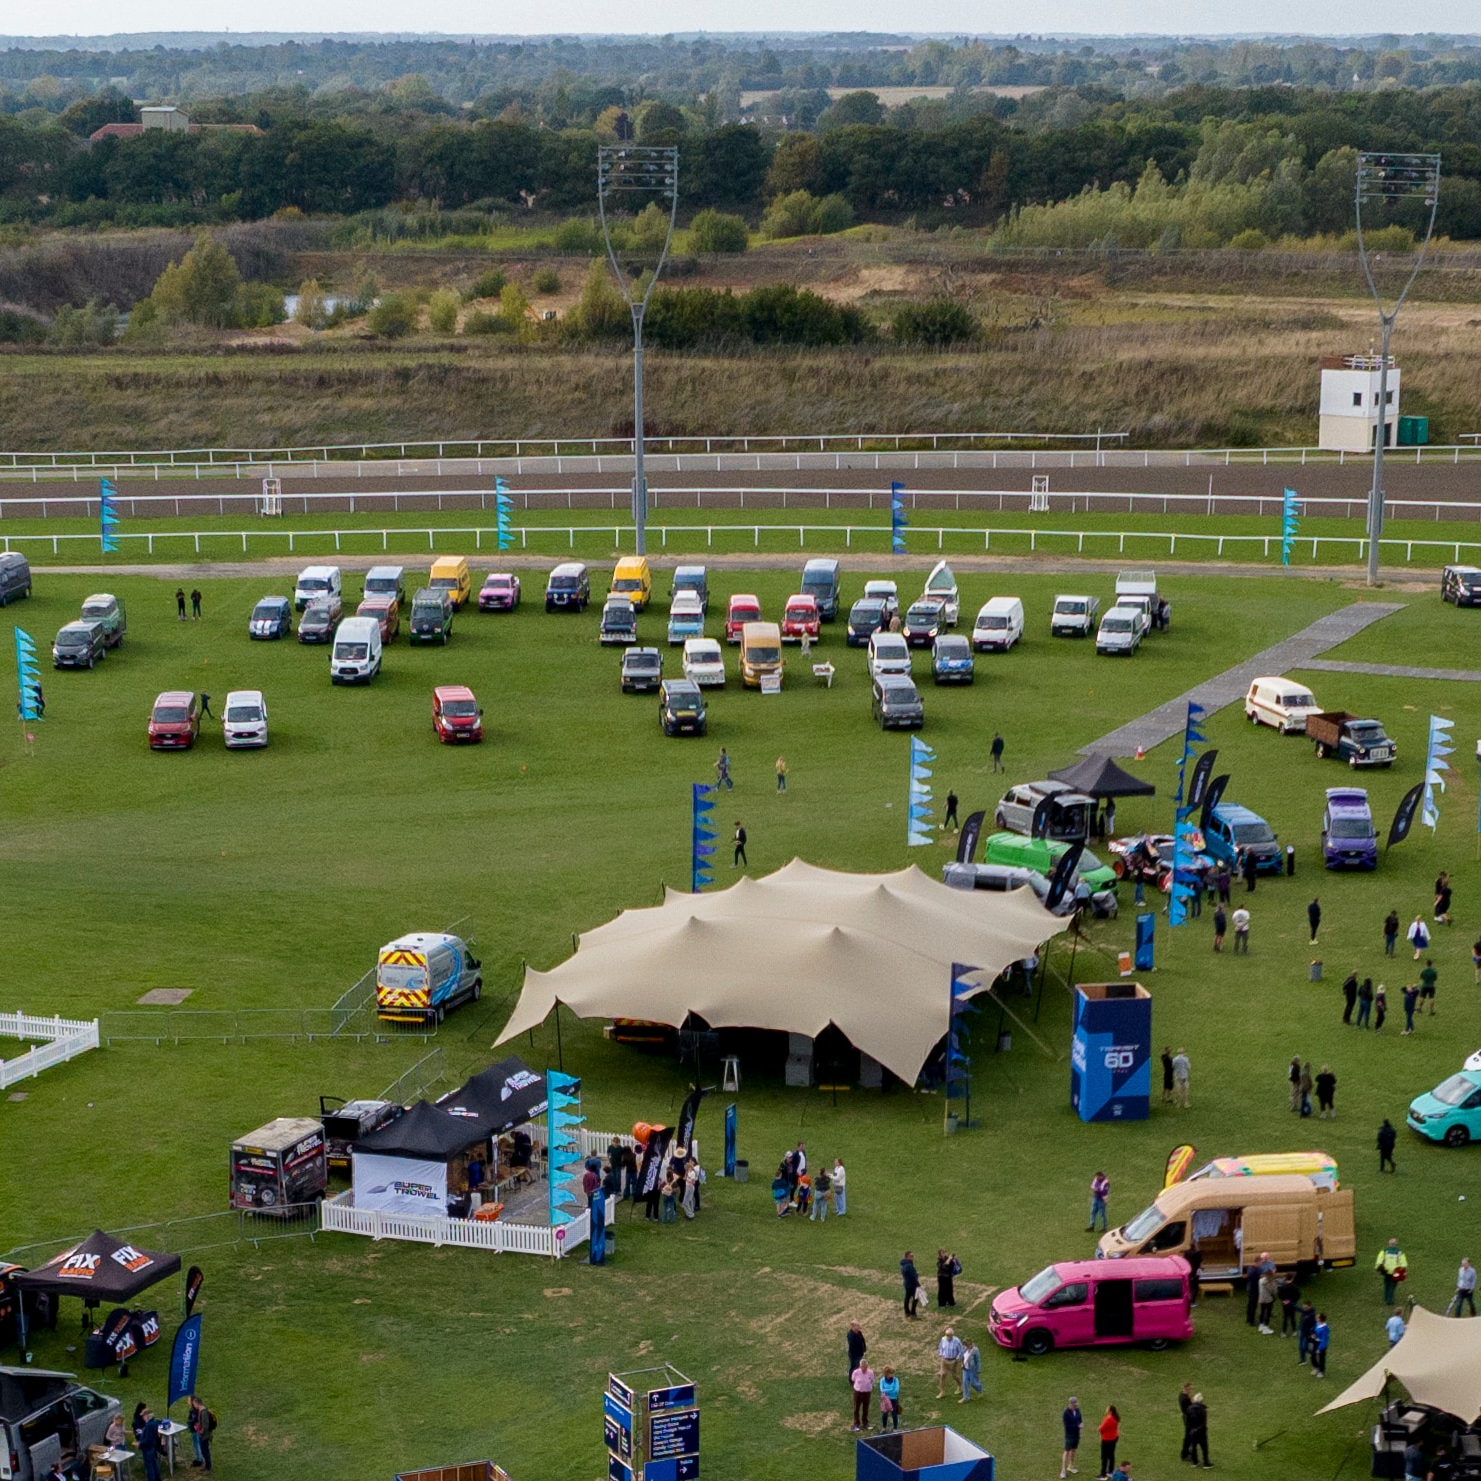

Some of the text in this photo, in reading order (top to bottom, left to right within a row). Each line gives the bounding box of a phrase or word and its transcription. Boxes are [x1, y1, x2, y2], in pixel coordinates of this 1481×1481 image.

[1104, 1052, 1134, 1068] 60
[395, 1188, 441, 1201] TROWEL
[63, 1252, 101, 1270] FIX
[111, 1245, 143, 1266] FIX
